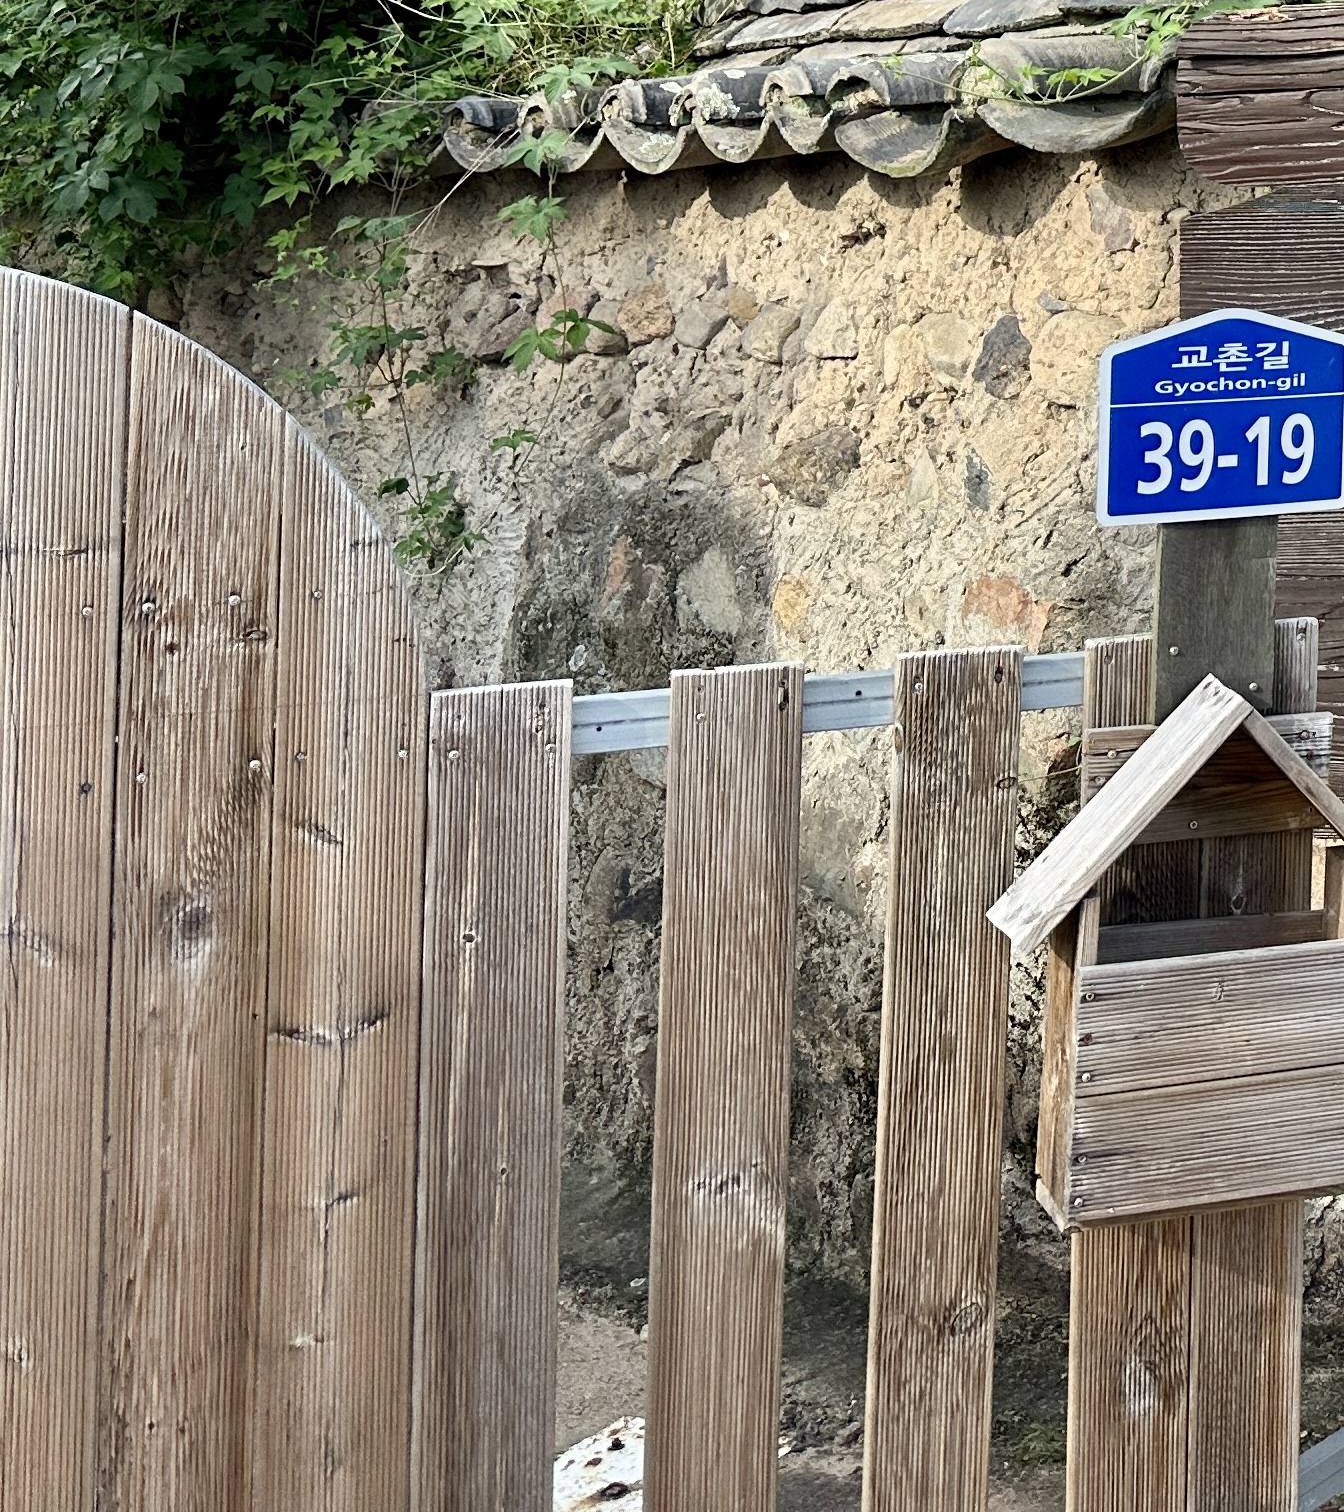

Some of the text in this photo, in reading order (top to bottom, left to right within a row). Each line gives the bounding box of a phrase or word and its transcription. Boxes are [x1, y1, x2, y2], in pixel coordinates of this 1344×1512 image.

[1171, 341, 1290, 372] 교촌길
[1155, 373, 1306, 397] Gyochon-gil
[1137, 413, 1315, 495] 39-19
